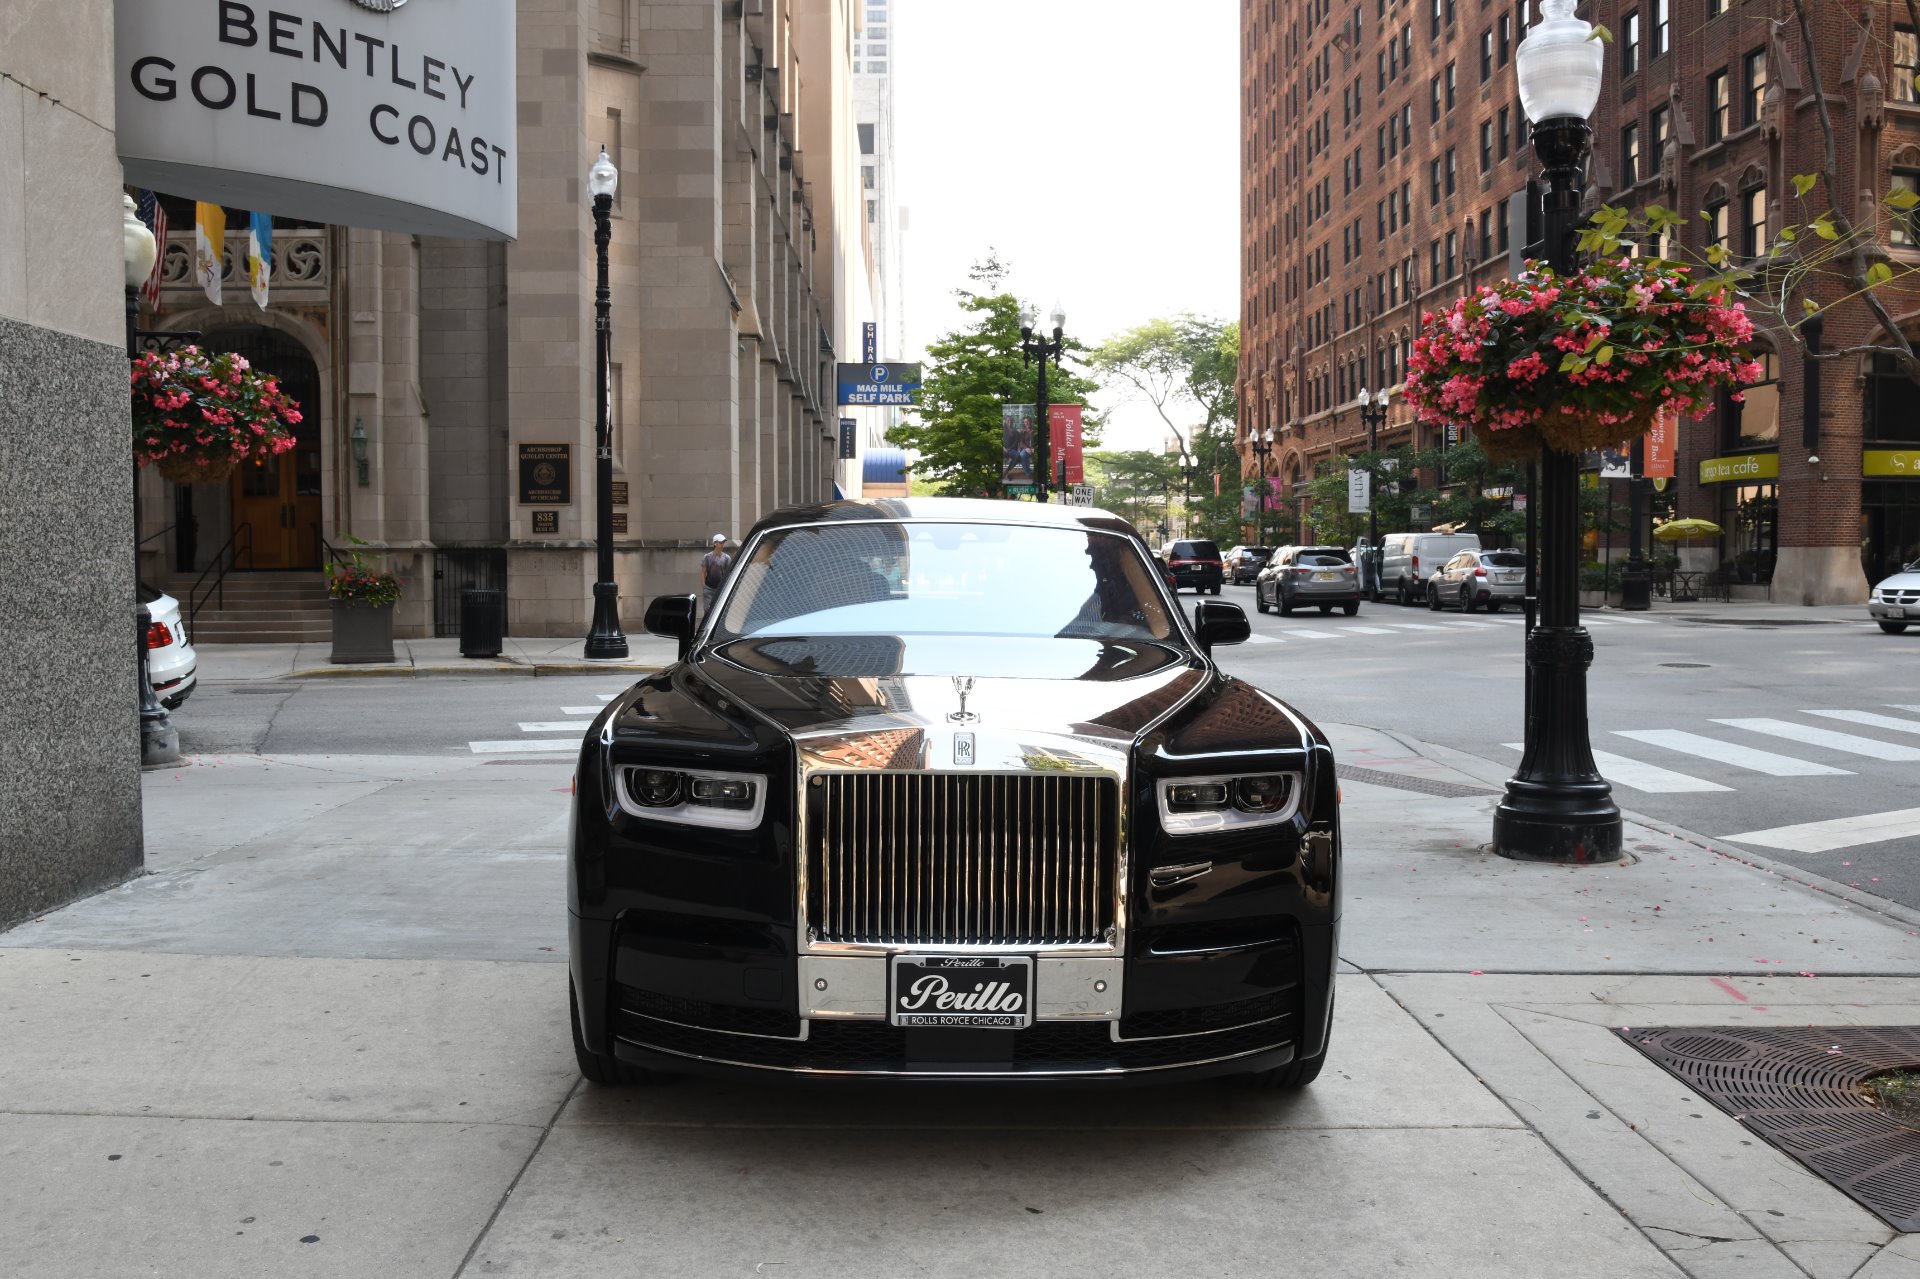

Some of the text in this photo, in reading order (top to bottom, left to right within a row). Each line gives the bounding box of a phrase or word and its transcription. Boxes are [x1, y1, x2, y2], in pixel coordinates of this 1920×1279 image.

[219, 0, 474, 108] BENTLEY
[131, 56, 506, 184] GOLD COAST
[857, 384, 902, 393] MAG MILE
[848, 394, 911, 403] SELF PARK
[1066, 419, 1074, 447] Folded
[1718, 464, 1730, 476] tea
[1733, 456, 1759, 474] café
[1076, 488, 1091, 496] ONE
[1075, 496, 1091, 504] WAY
[537, 512, 553, 522] 835
[940, 958, 984, 967] Perillo
[900, 974, 1023, 1012] Perillo
[911, 1016, 938, 1025] ROLLS
[940, 1016, 970, 1025] ROYCE
[972, 1016, 1011, 1025] CHICAGO
